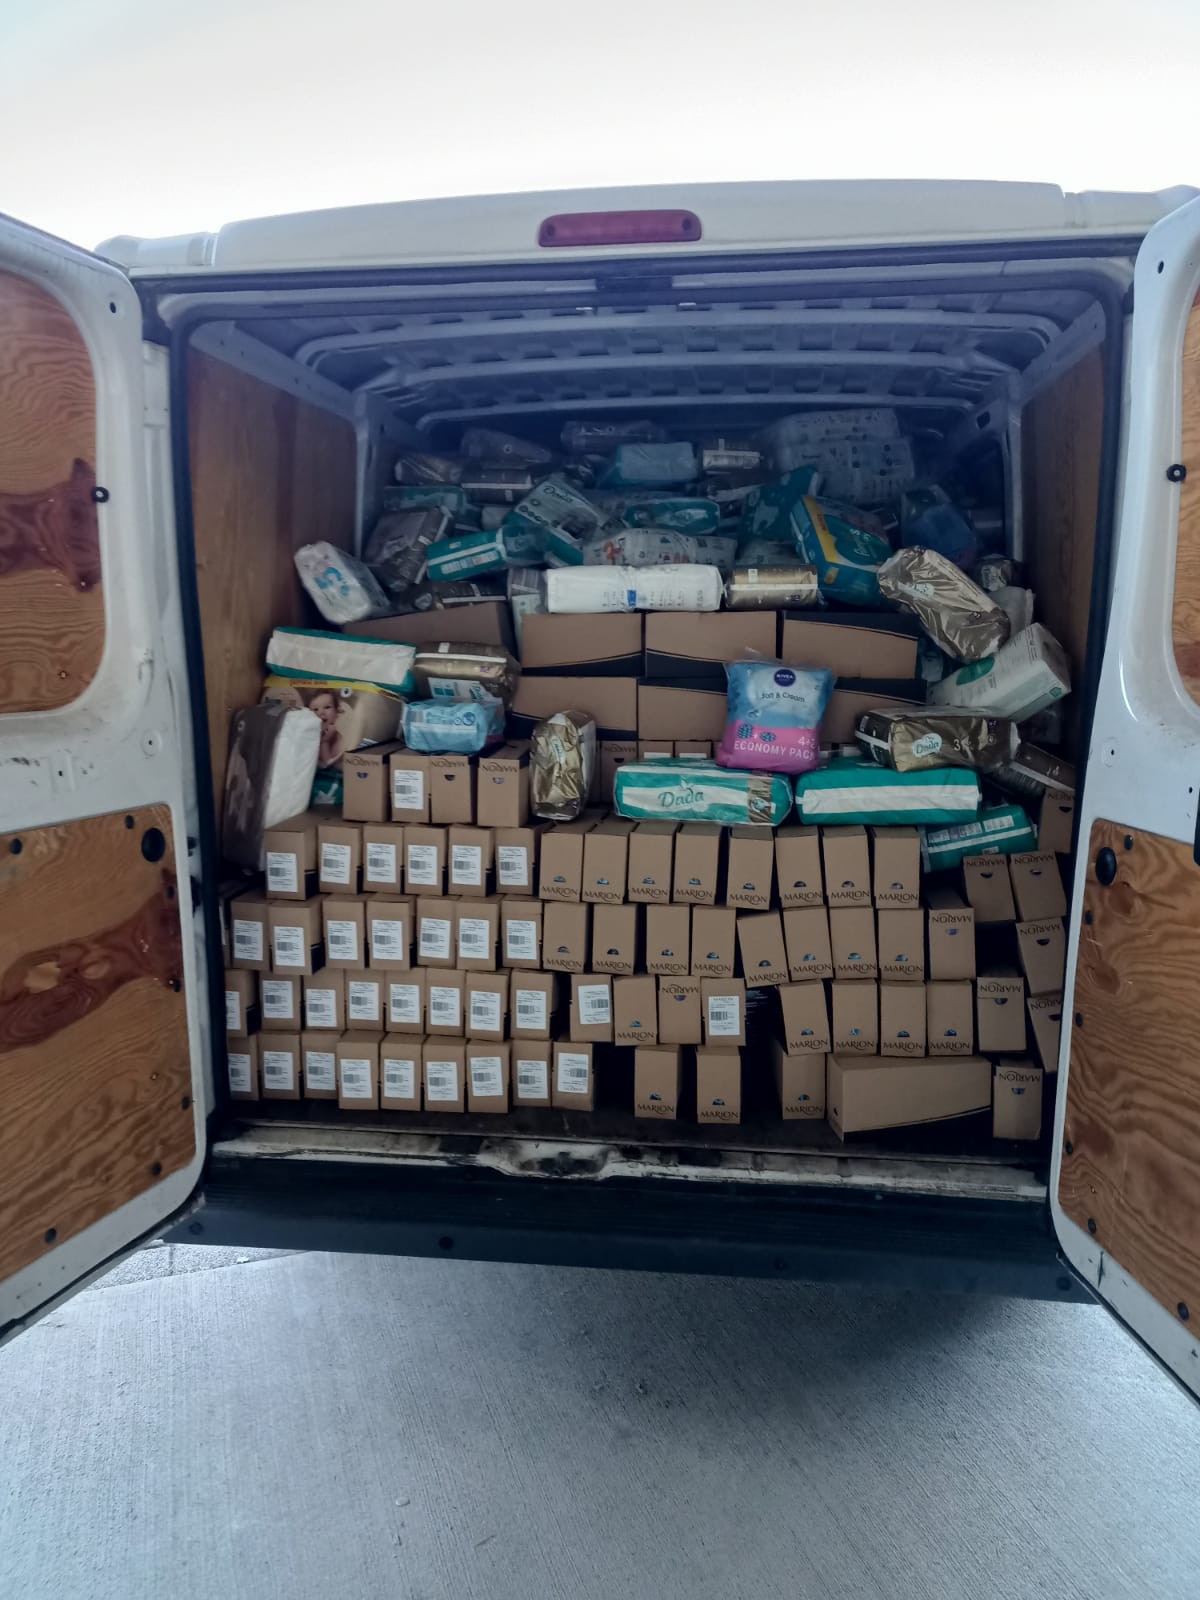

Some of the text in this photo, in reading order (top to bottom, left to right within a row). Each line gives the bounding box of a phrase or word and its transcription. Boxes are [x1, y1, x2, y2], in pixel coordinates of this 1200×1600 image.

[782, 692, 805, 703] Cream
[734, 740, 786, 755] ECONOMY
[657, 788, 705, 808] Dada
[965, 854, 1005, 867] MARION
[1014, 853, 1055, 865] MARION
[542, 885, 578, 898] MARION
[583, 889, 622, 901] MARION
[631, 886, 668, 899] MARION
[675, 887, 712, 900] MARION
[783, 890, 822, 903] MARION
[830, 889, 870, 902] MARION
[729, 892, 768, 905] MARION
[878, 892, 919, 905] MARION
[931, 911, 972, 924] MARION
[1019, 922, 1062, 937] MARION
[545, 958, 582, 970] MARION
[595, 960, 632, 972] MARION
[649, 962, 687, 974] MARION
[693, 962, 732, 975] MARION
[792, 962, 832, 976] MARION
[837, 962, 878, 975] MARION
[882, 963, 923, 976] MARION
[748, 970, 787, 984] MARION
[661, 983, 699, 995] MARION
[979, 980, 1022, 994] MARION
[616, 1031, 655, 1043] MARION
[789, 1038, 829, 1051] MARION
[835, 1039, 875, 1052] MARION
[882, 1039, 924, 1053] MARION
[928, 1039, 971, 1052] MARION
[998, 1070, 1042, 1083] MARION
[637, 1103, 675, 1116] MARION
[700, 1110, 739, 1122] MARION
[785, 1104, 824, 1117] MARION
